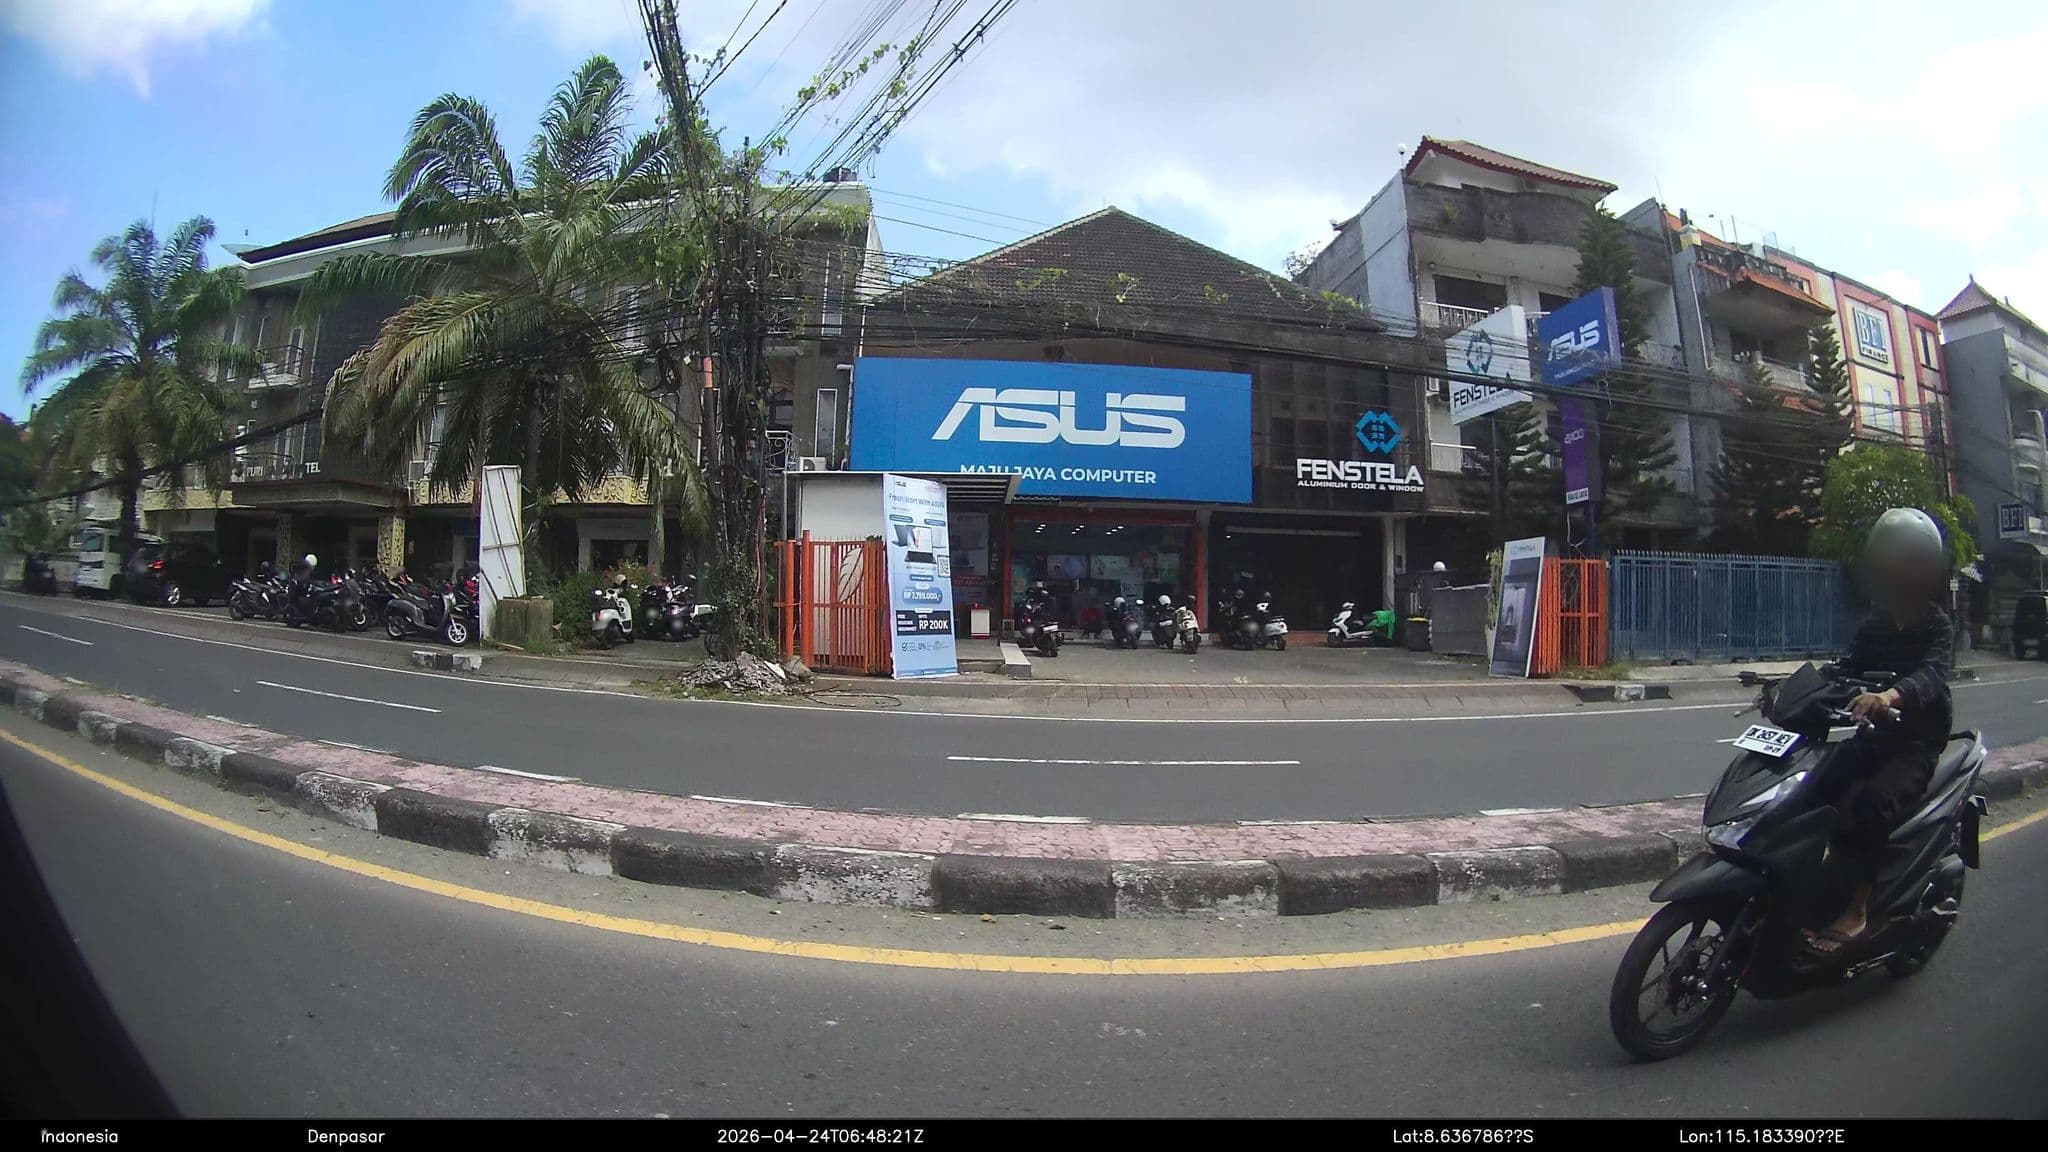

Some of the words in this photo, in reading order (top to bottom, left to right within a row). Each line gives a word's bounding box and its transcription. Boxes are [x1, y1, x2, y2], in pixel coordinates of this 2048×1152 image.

[1548, 319, 1600, 362] ASUS
[1857, 312, 1886, 350] BFI
[931, 387, 1186, 449] ASUS
[1014, 465, 1057, 481] JAYA
[1061, 468, 1157, 484] COMPUTER
[1297, 458, 1424, 485] FENSTELA
[1297, 480, 1348, 489] ALUMINIUM
[1351, 482, 1376, 491] DOOR
[1388, 485, 1425, 493] WINDOW
[2002, 507, 2024, 528] BFI
[919, 619, 928, 630] RP
[929, 619, 949, 630] 200K
